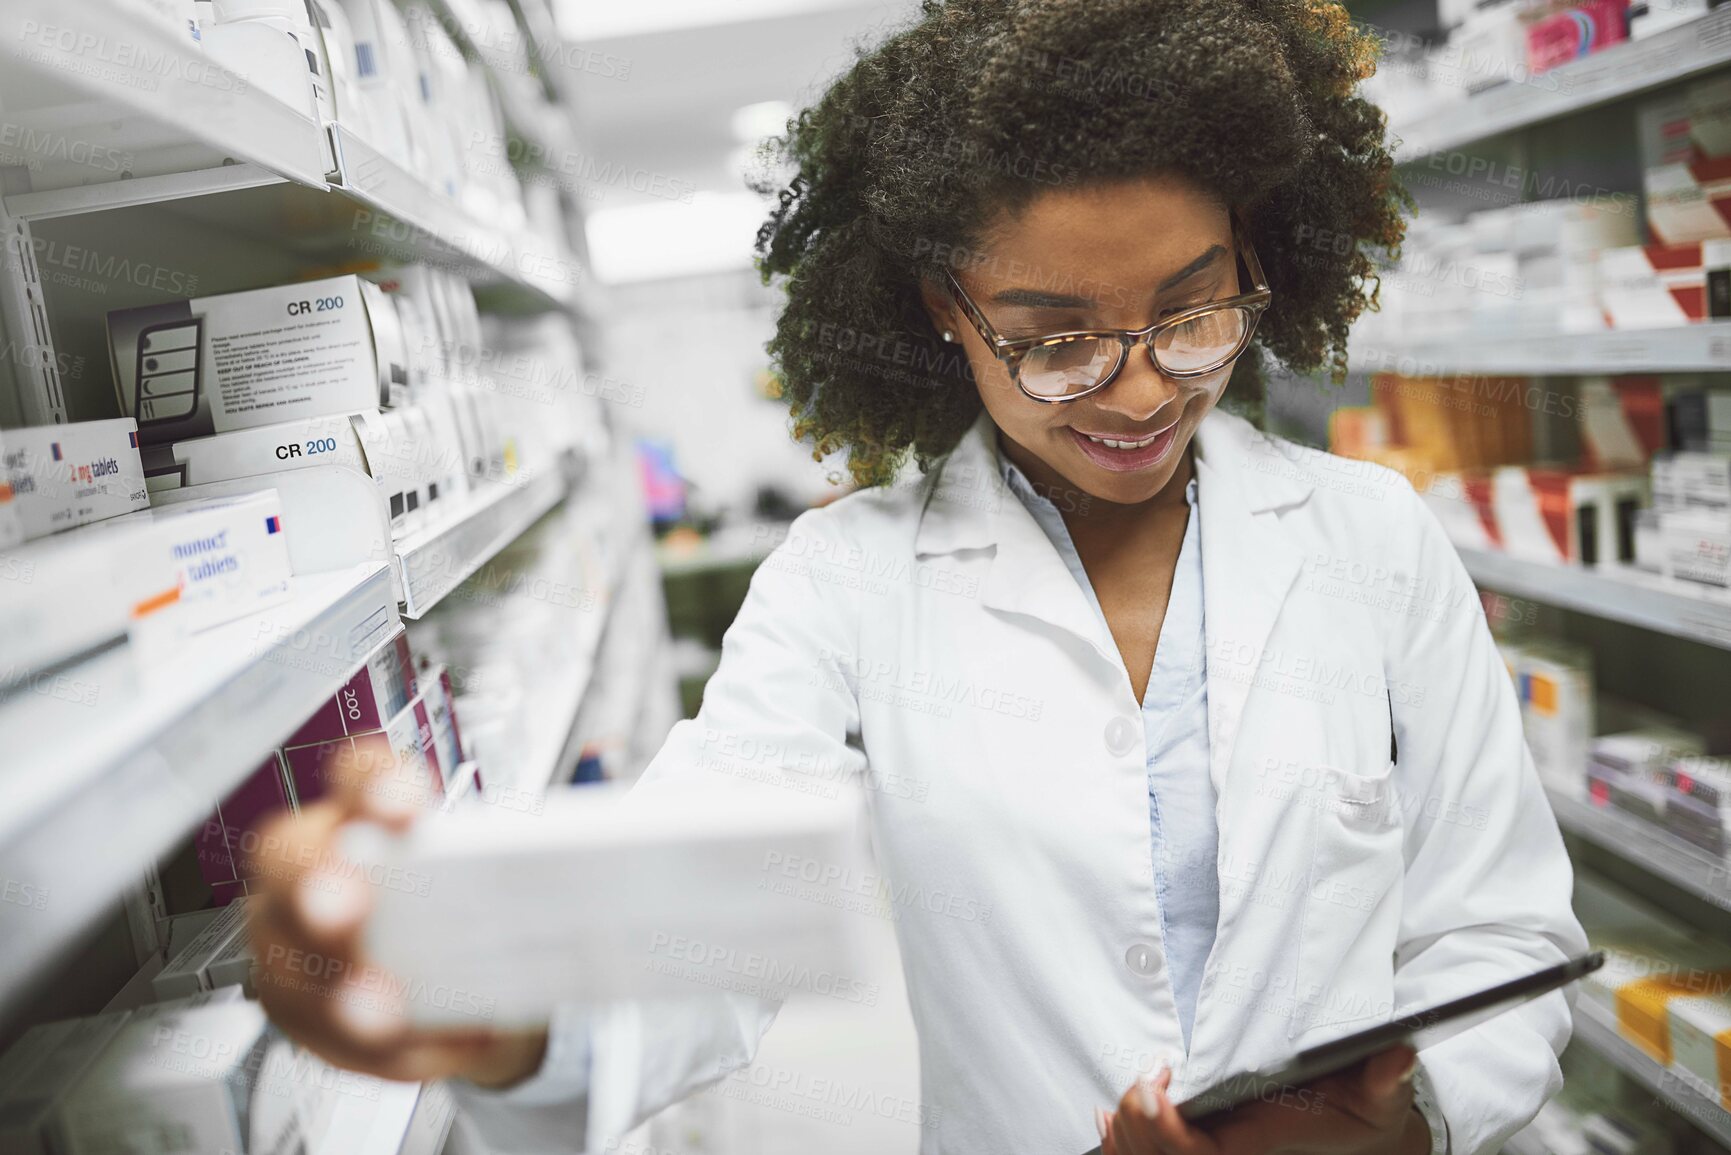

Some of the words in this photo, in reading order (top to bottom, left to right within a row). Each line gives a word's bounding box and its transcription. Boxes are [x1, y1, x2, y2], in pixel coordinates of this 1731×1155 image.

[287, 301, 311, 316] CR
[316, 296, 343, 312] 200
[276, 443, 302, 460] CR
[306, 438, 336, 456] 200
[69, 464, 77, 482] 2
[78, 463, 93, 483] mg
[92, 457, 119, 477] tablets
[344, 688, 361, 720] 200
